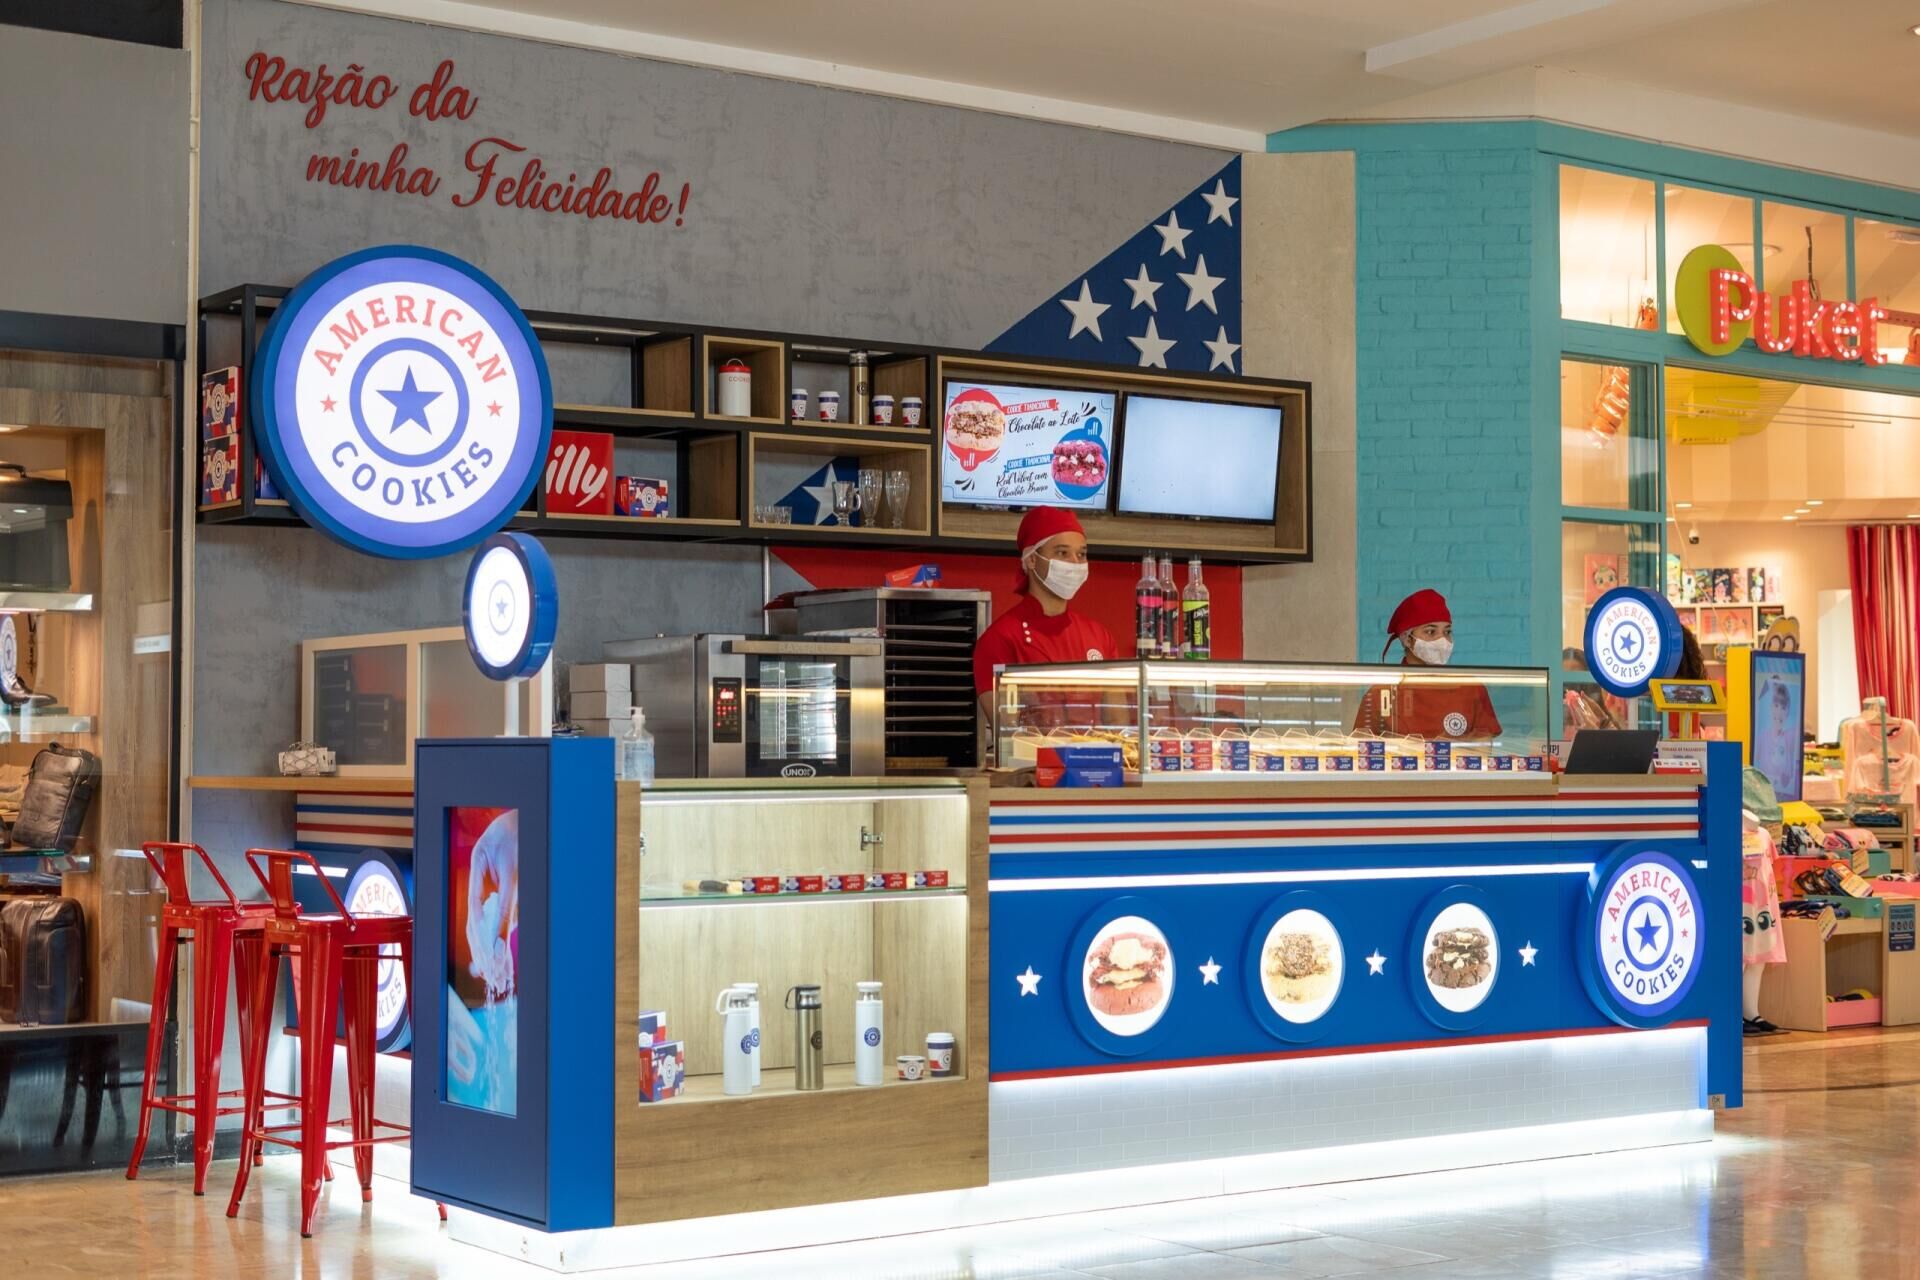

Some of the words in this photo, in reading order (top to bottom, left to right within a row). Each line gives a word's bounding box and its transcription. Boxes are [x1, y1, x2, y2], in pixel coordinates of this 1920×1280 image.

[245, 52, 398, 129] Razão
[409, 60, 479, 121] da
[306, 143, 440, 197] minha
[451, 137, 690, 227] Felicidade!
[314, 295, 507, 384] AMERICAN
[1008, 415, 1046, 433] Chocolate
[1048, 419, 1056, 427] ao
[1060, 410, 1080, 426] Leite
[332, 440, 494, 506] COOKIES
[546, 444, 608, 507] illy
[998, 486, 1026, 498] Chocolate
[1606, 605, 1657, 645] AMERICAN
[1602, 647, 1646, 678] COOKIES
[1607, 870, 1691, 922] AMERICAN
[1614, 952, 1686, 996] COOKIES
